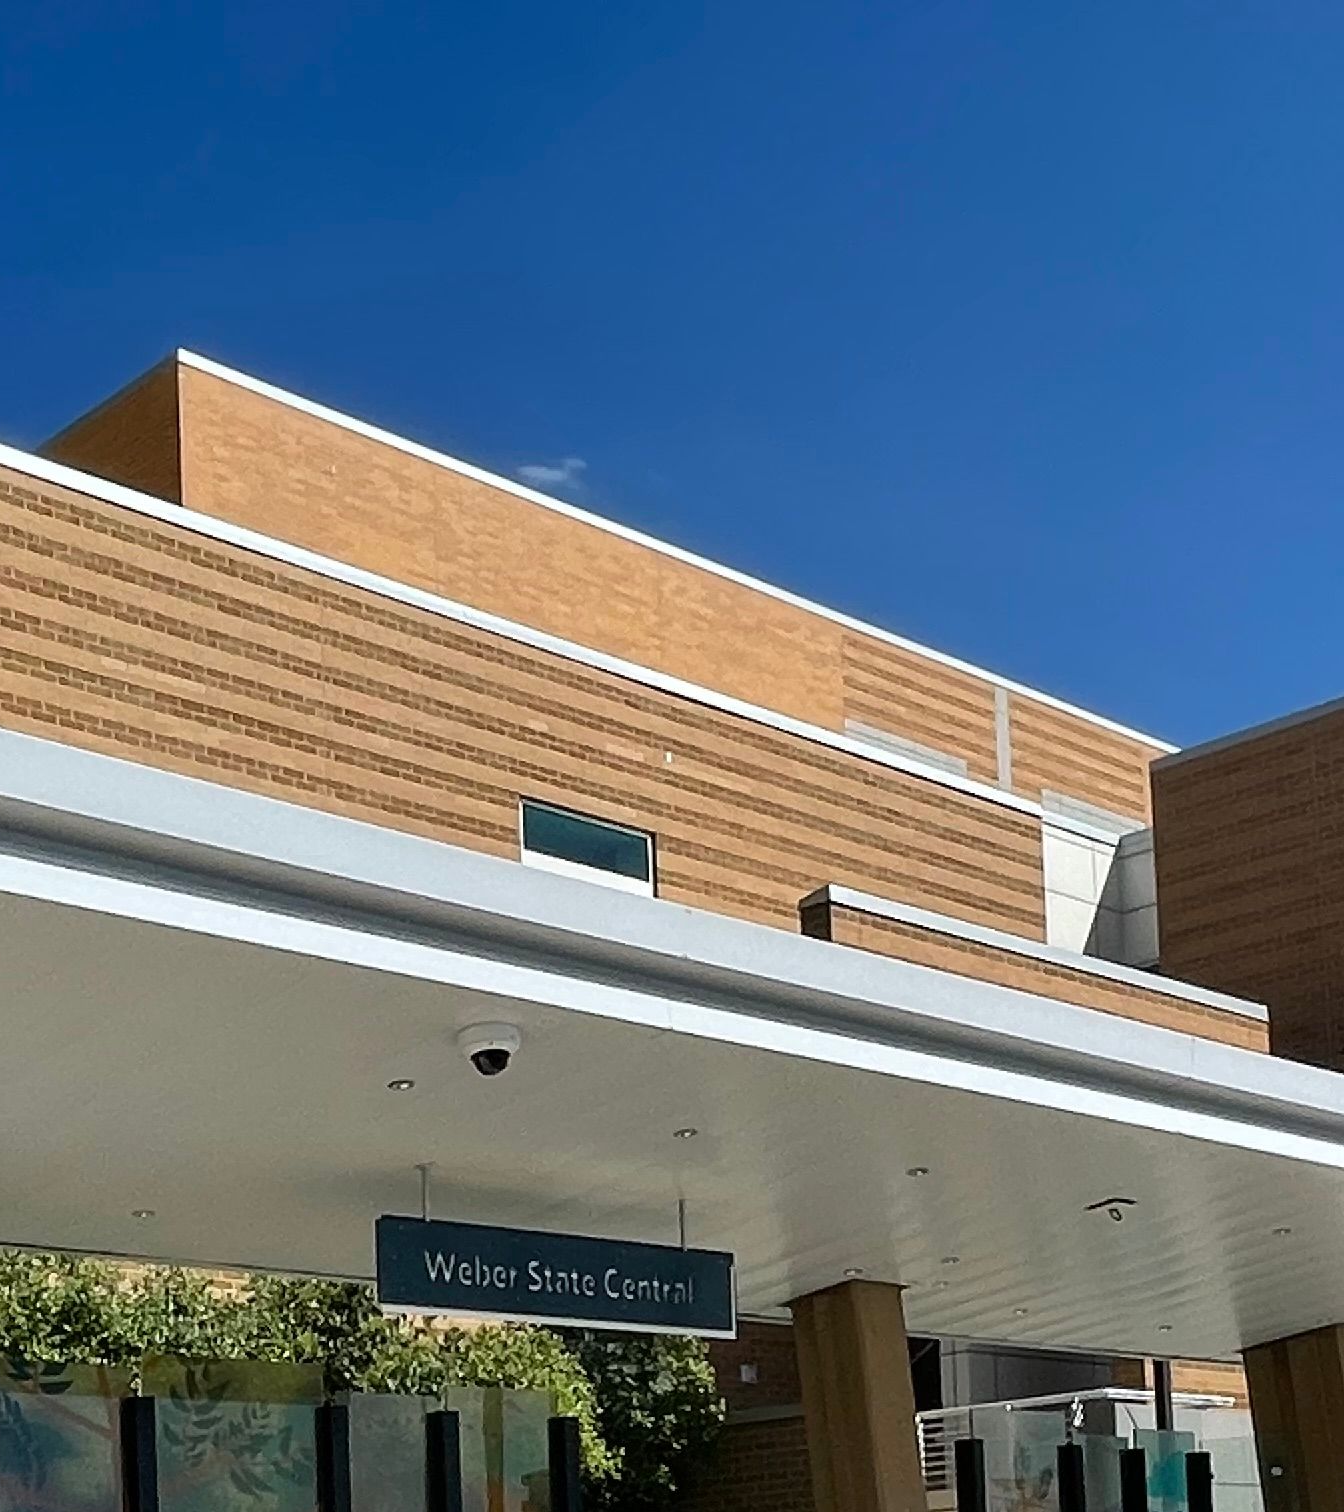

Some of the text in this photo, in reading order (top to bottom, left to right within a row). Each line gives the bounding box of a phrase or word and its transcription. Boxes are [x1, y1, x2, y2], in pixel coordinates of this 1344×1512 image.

[423, 1249, 695, 1304] Weber State Central
